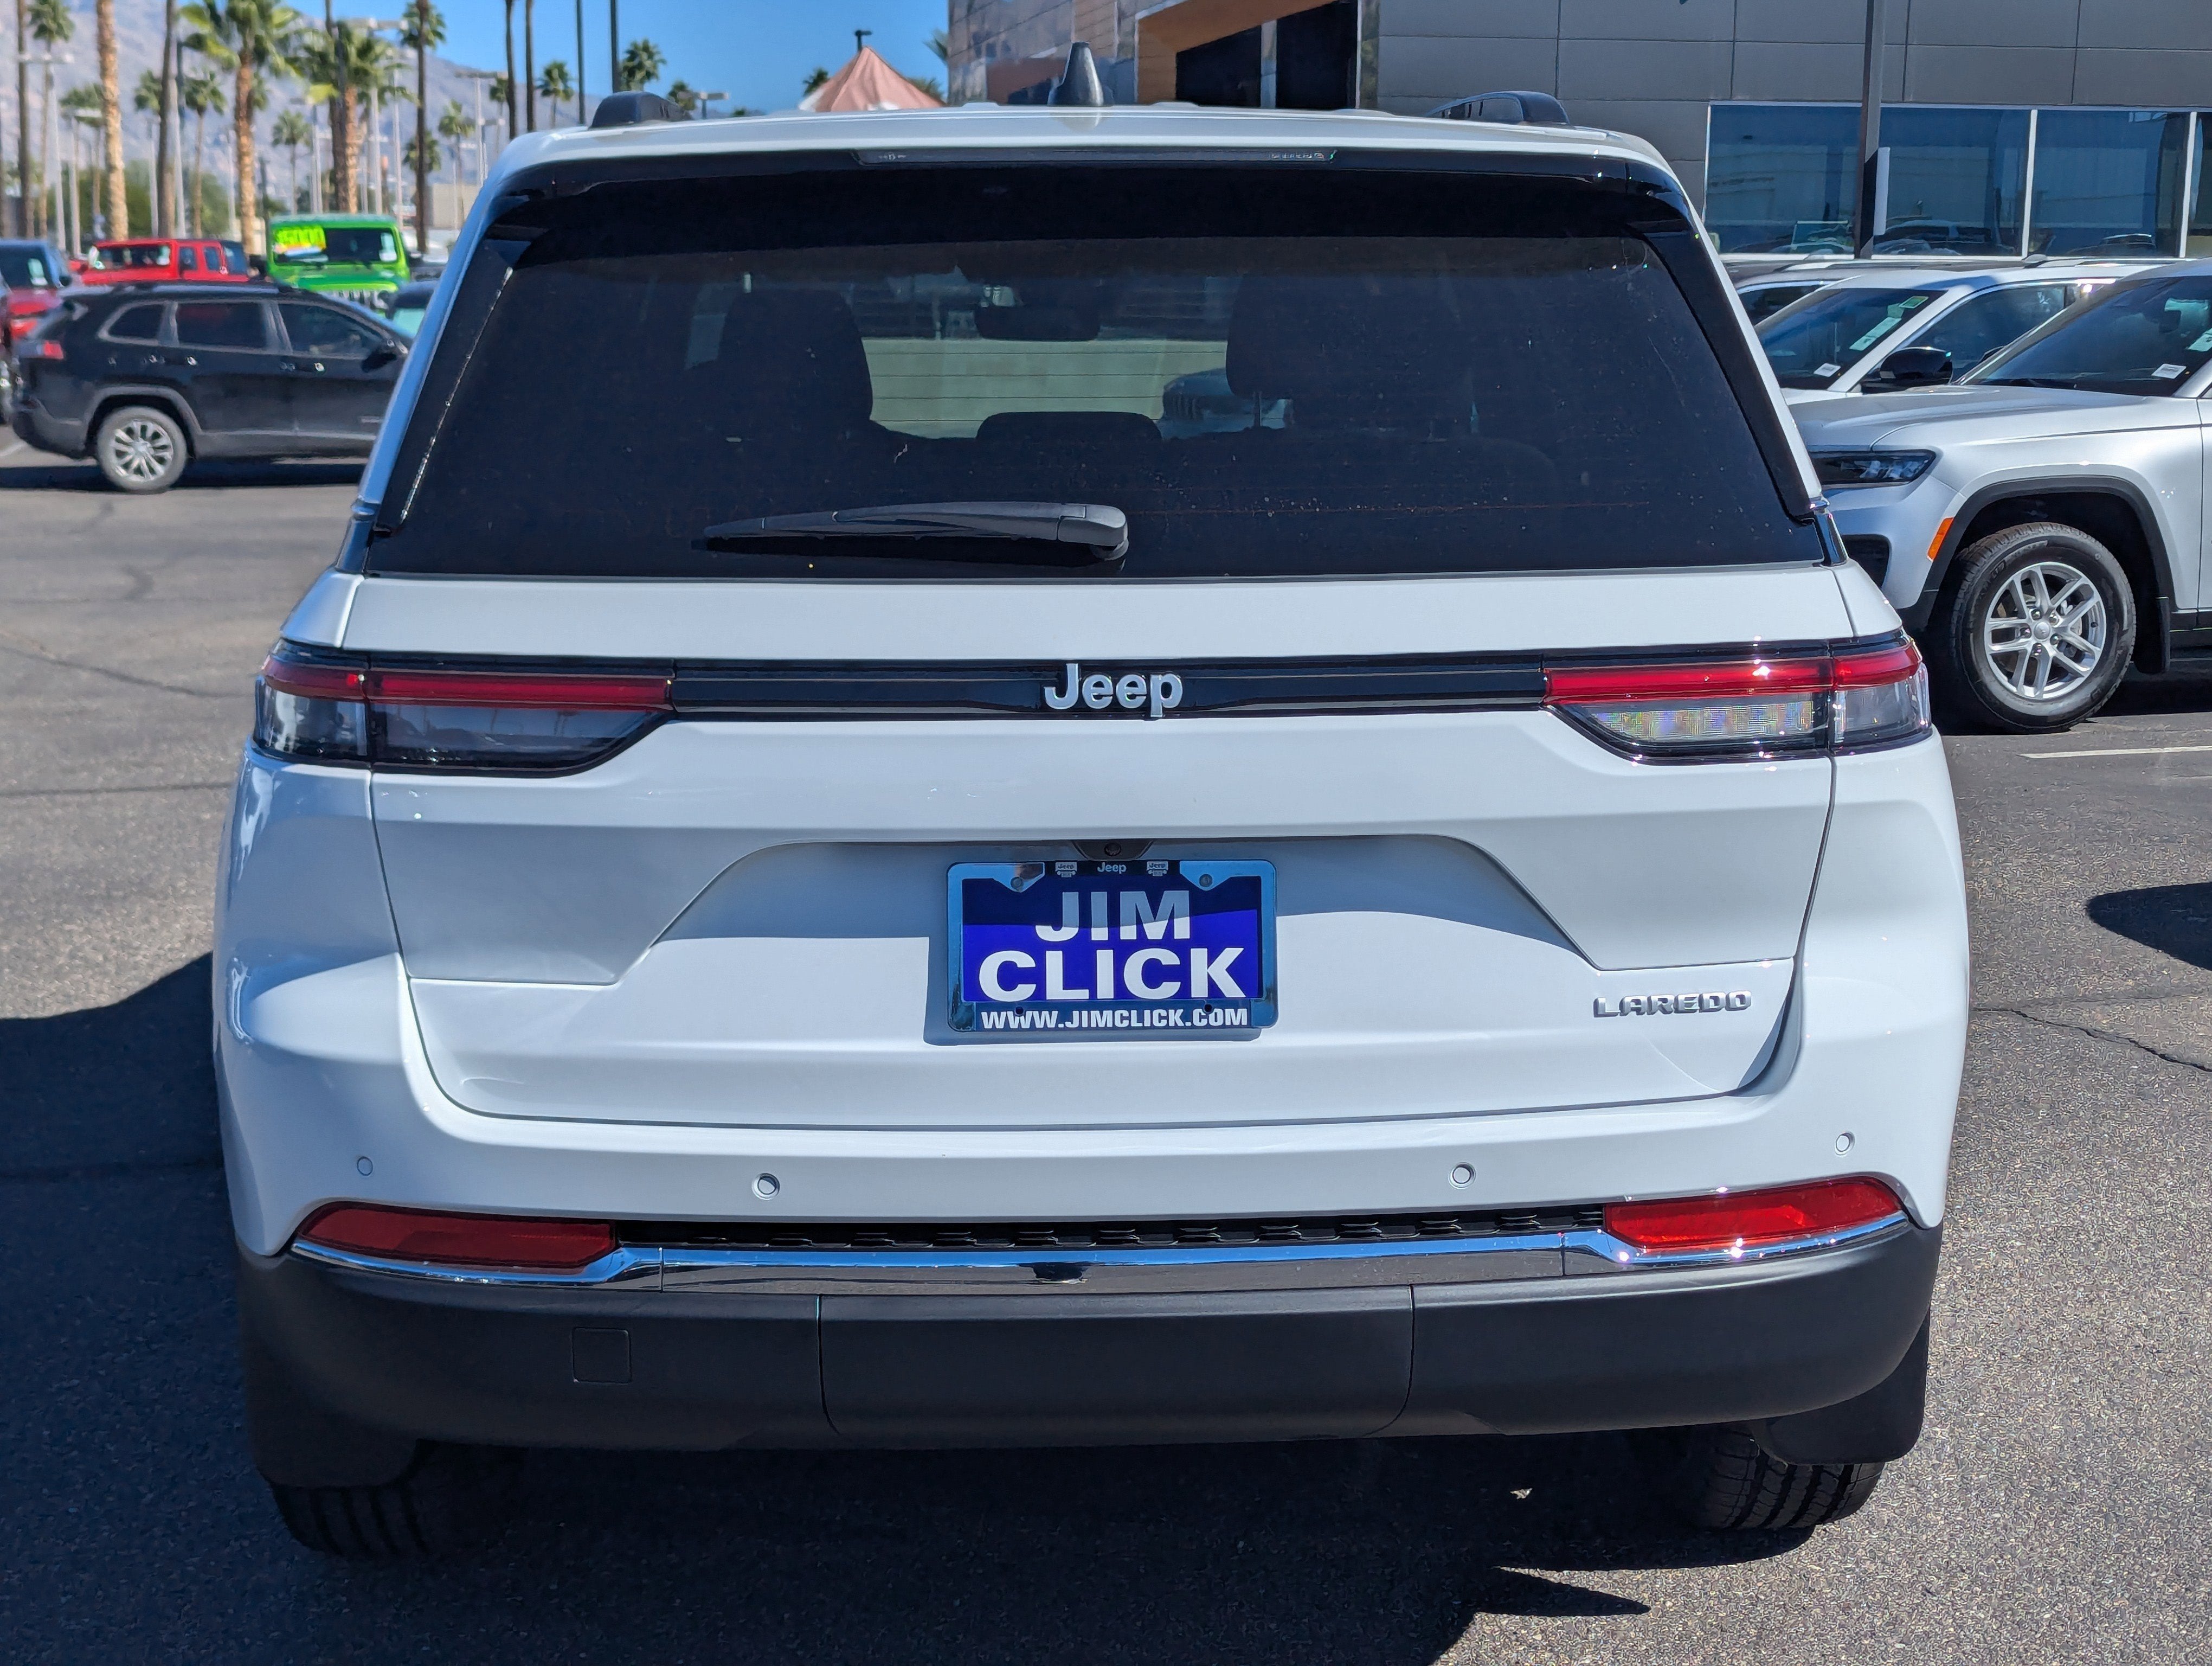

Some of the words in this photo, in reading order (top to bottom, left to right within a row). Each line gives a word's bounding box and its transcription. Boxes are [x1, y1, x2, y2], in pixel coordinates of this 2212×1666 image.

[1044, 663, 1183, 717] Jeep
[1097, 862, 1127, 874] Jeep
[1035, 890, 1190, 941] JIM
[979, 947, 1246, 1002] CLICK
[981, 1008, 1248, 1029] WWW.JIMCLICK.COM
[1593, 990, 1752, 1018] LAREDO
